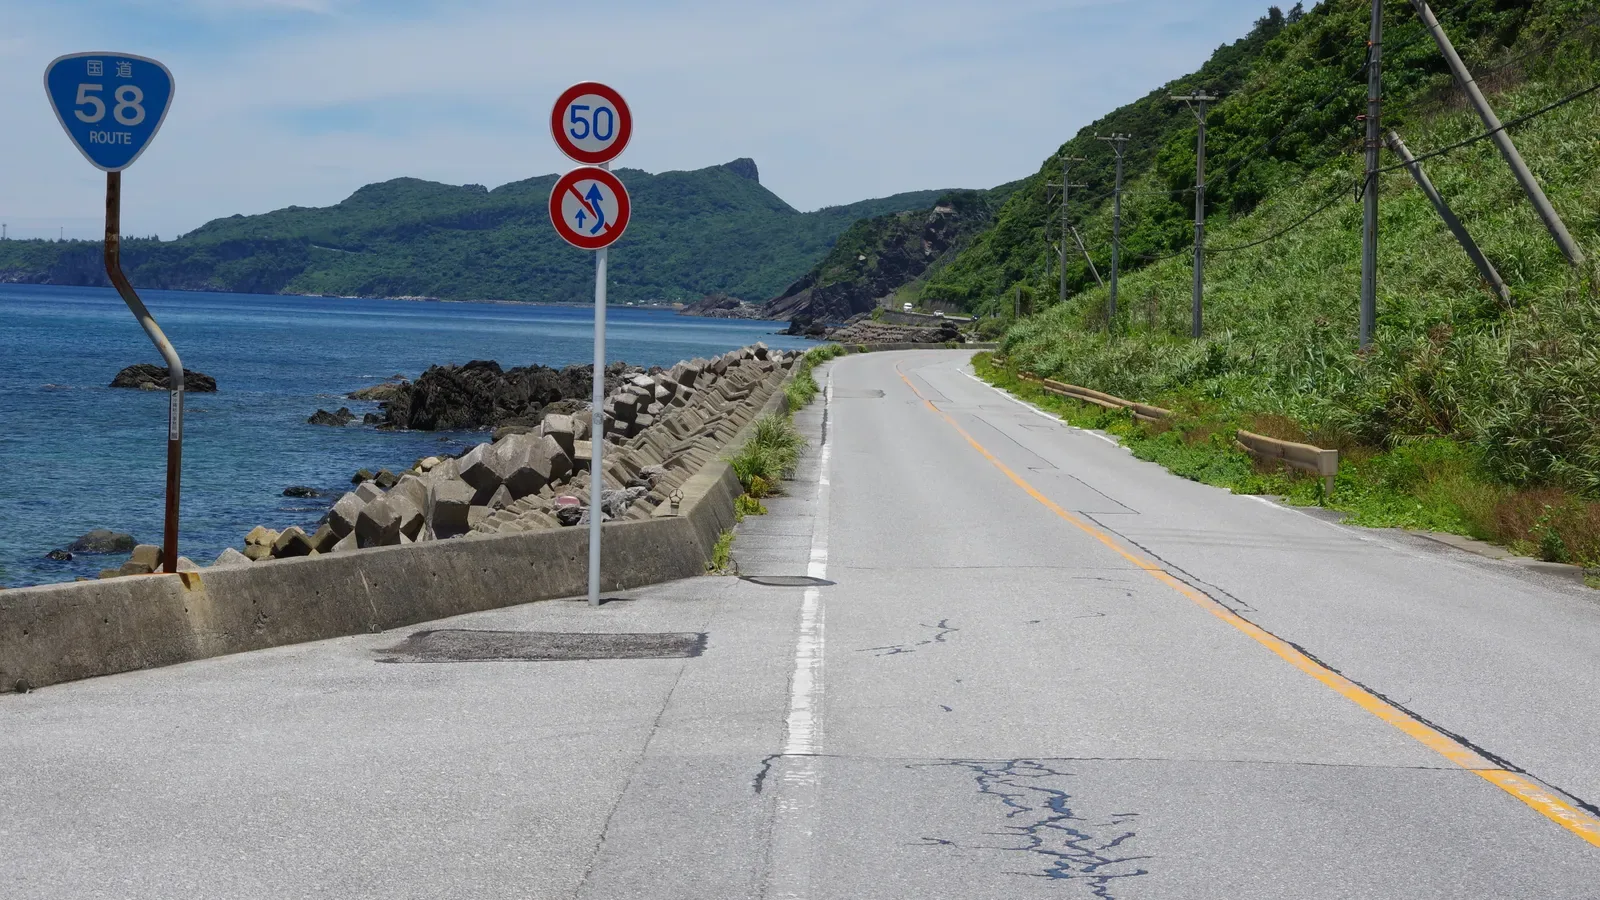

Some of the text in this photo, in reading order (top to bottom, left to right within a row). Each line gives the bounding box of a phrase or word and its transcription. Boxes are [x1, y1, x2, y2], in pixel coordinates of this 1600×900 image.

[87, 60, 132, 78] 国道
[74, 83, 146, 126] 58
[570, 105, 614, 141] 50
[89, 130, 132, 145] ROUTE
